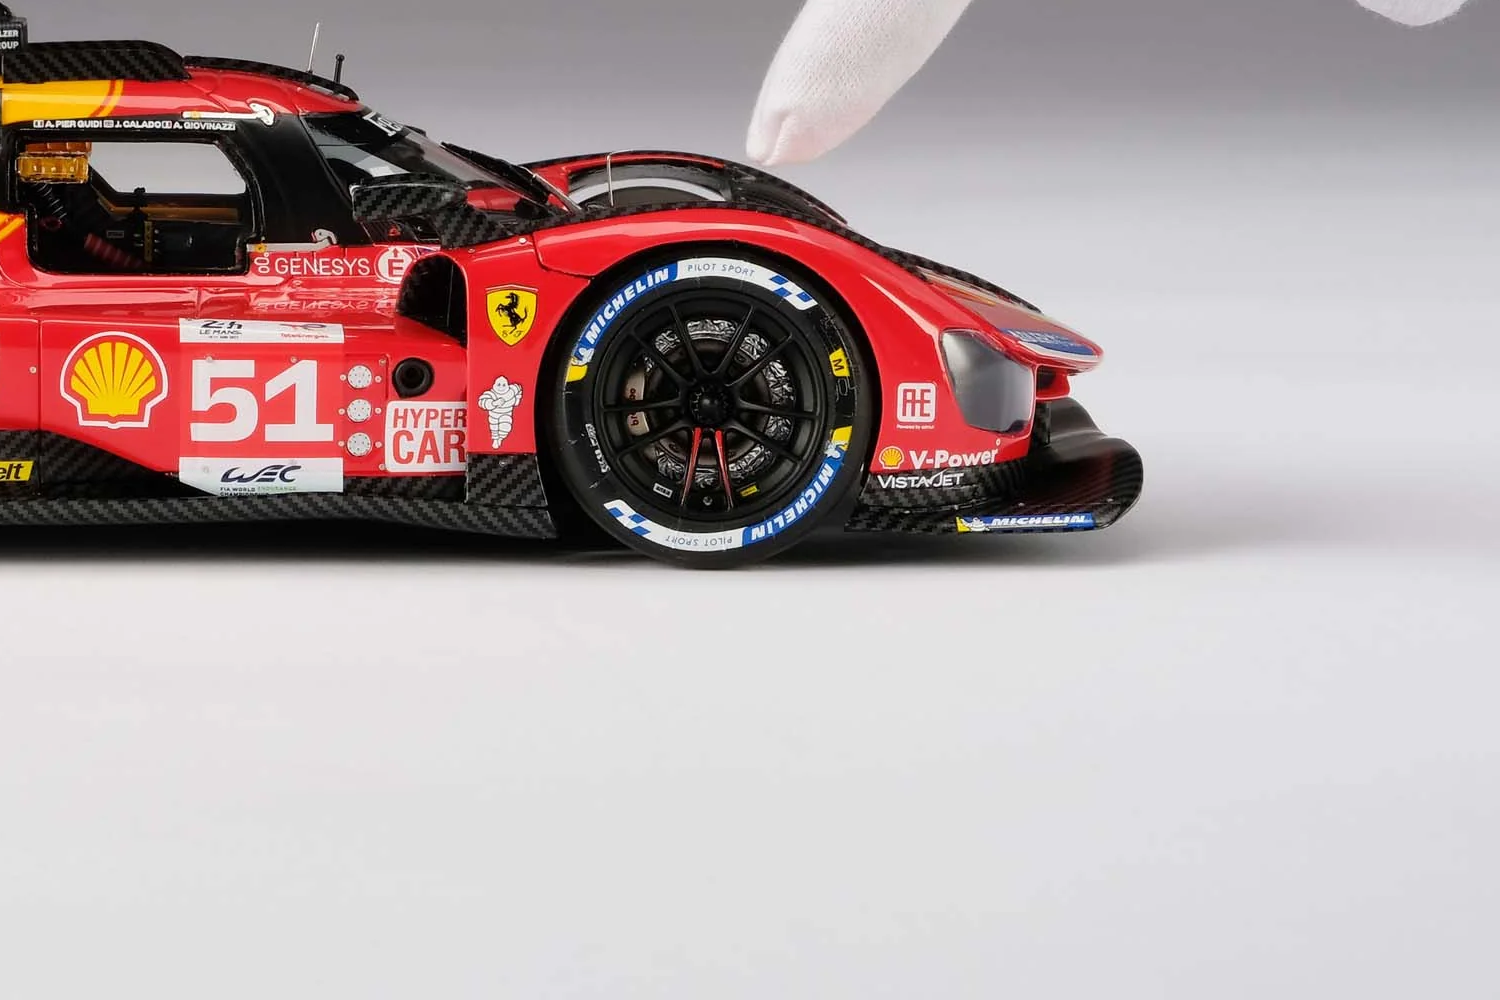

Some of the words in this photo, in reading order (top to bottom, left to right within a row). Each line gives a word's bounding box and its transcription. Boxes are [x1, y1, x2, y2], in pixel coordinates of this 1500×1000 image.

[55, 120, 76, 128] PIER
[77, 120, 102, 128] GUIDI
[183, 121, 236, 131] GIOVINAZZI
[274, 257, 371, 276] GENESYS
[687, 263, 717, 273] PILOT
[722, 263, 756, 277] SPORT
[584, 267, 670, 346] MICHELIN
[190, 359, 334, 442] 51
[392, 407, 468, 429] HYPER
[392, 429, 467, 464] CAR
[909, 447, 999, 470] V-Power
[220, 464, 302, 483] WEC
[751, 463, 835, 541] MICHELIN
[991, 515, 1086, 526] MICHELIN
[665, 535, 699, 546] SPORT
[704, 536, 733, 546] PILOT
